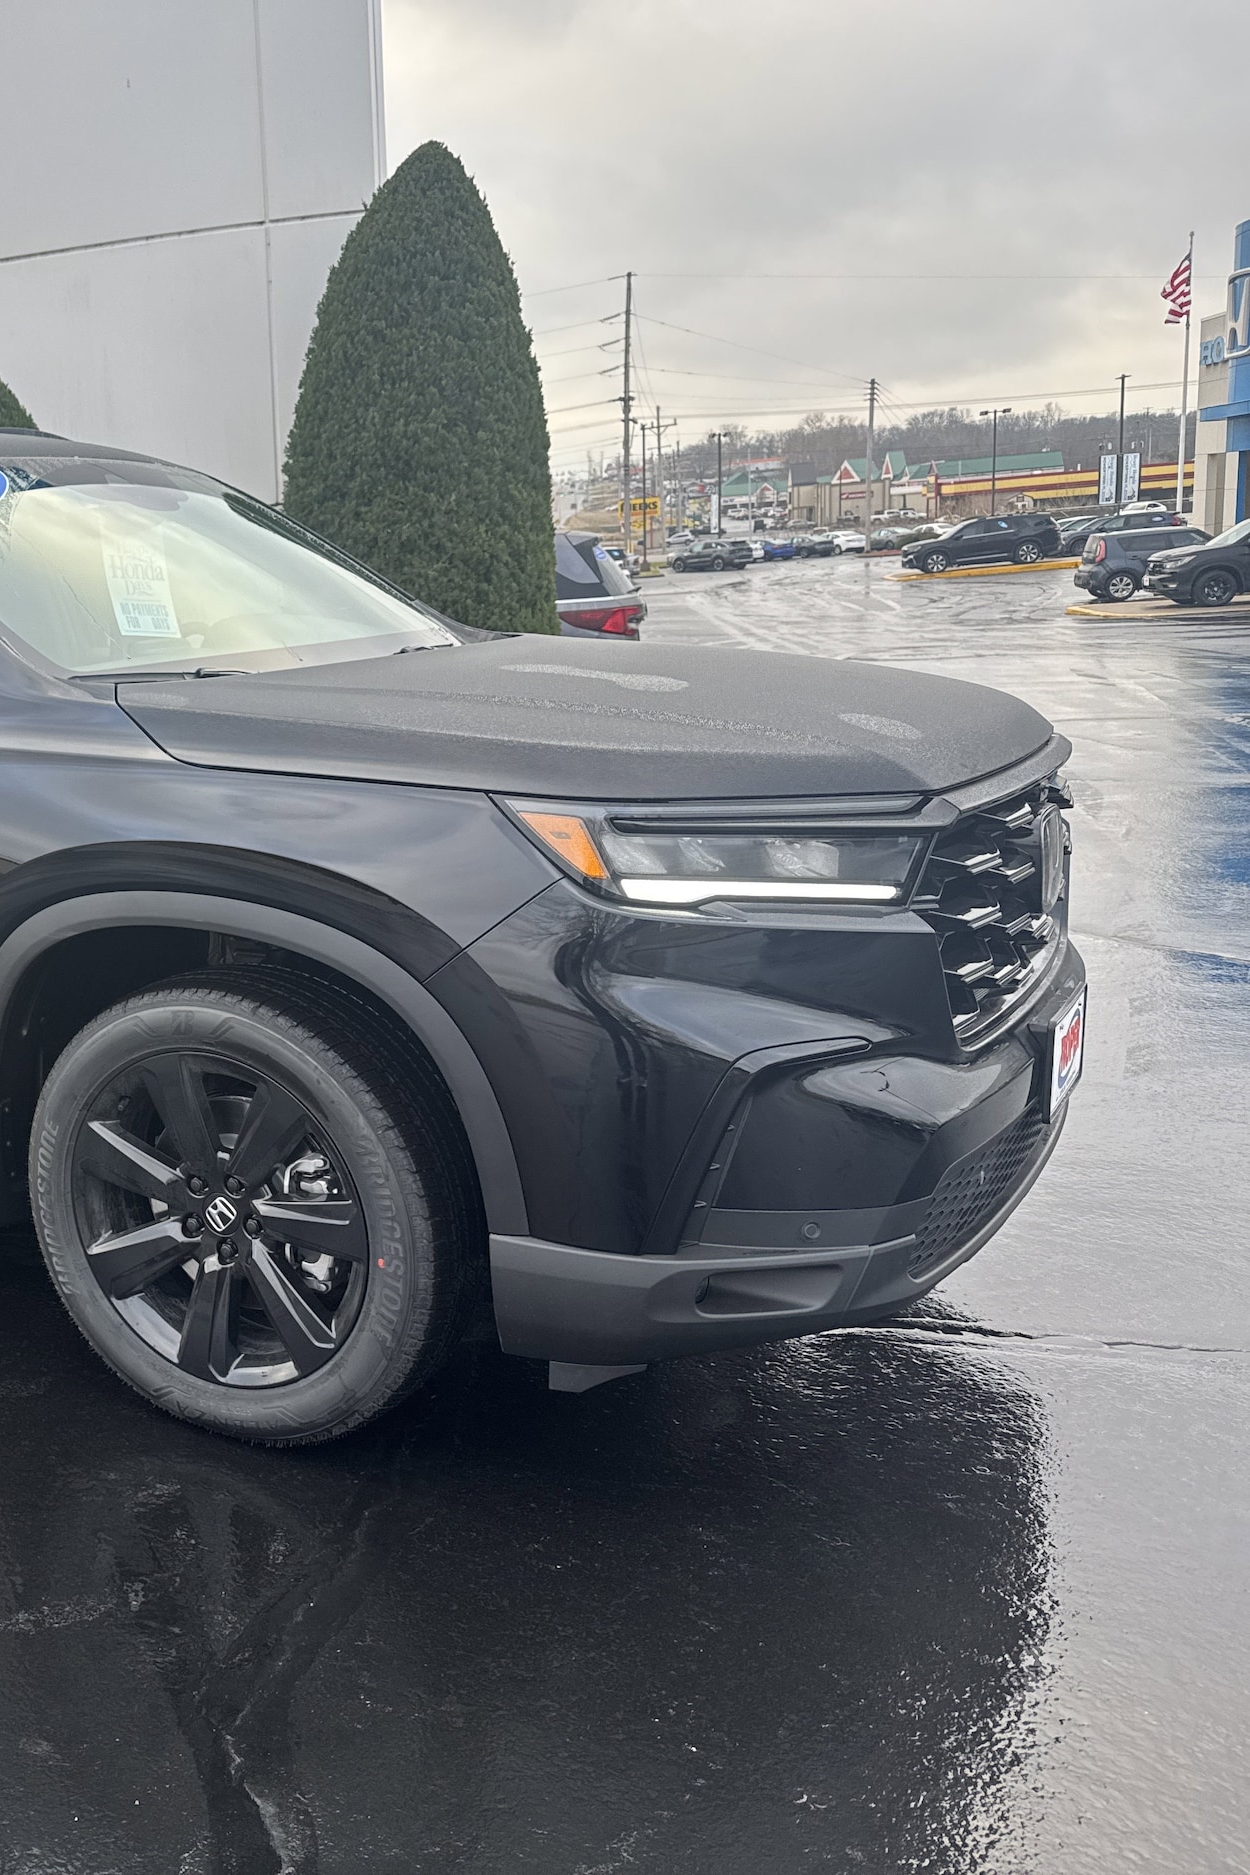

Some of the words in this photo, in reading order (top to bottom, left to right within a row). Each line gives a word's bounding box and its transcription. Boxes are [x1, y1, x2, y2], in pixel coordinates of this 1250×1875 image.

[108, 554, 165, 582] Honda
[120, 602, 131, 616] NO
[131, 602, 169, 617] PAYMENTS
[125, 616, 141, 629] FOR
[151, 617, 171, 631] DAYS
[37, 1115, 80, 1295] BRIDGESTONE
[355, 1136, 404, 1347] BRIDGESTONE
